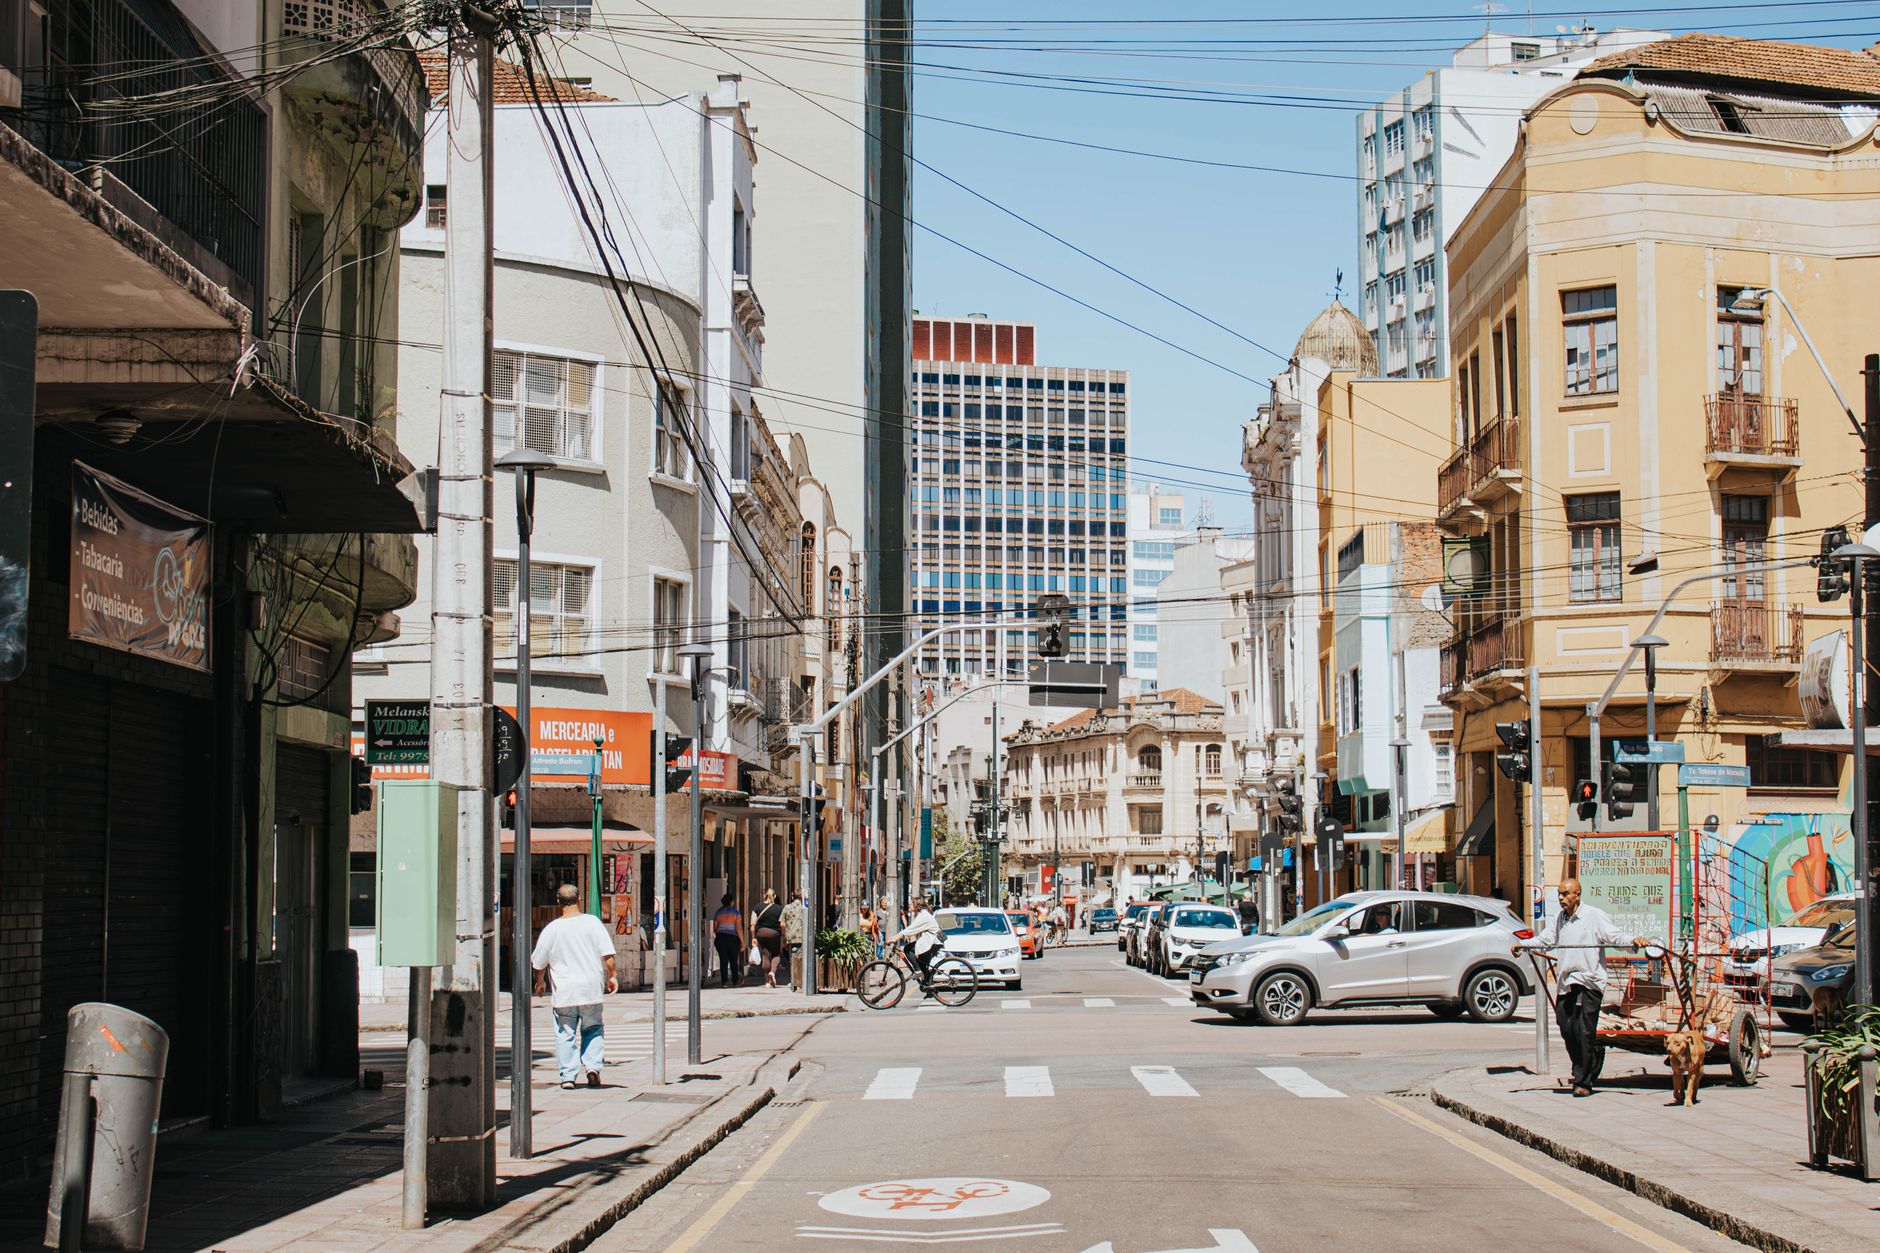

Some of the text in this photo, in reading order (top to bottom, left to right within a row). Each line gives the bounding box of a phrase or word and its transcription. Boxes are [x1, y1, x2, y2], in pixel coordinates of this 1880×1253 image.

[81, 498, 119, 536] Bebidas
[81, 540, 124, 579] Tabacaria
[81, 584, 144, 625] Conveniências
[182, 624, 205, 649] GOLE
[374, 706, 430, 717] Melansk
[373, 719, 430, 735] VIDRA
[540, 720, 615, 742] MERCEARIA e
[376, 752, 397, 761] Tel:
